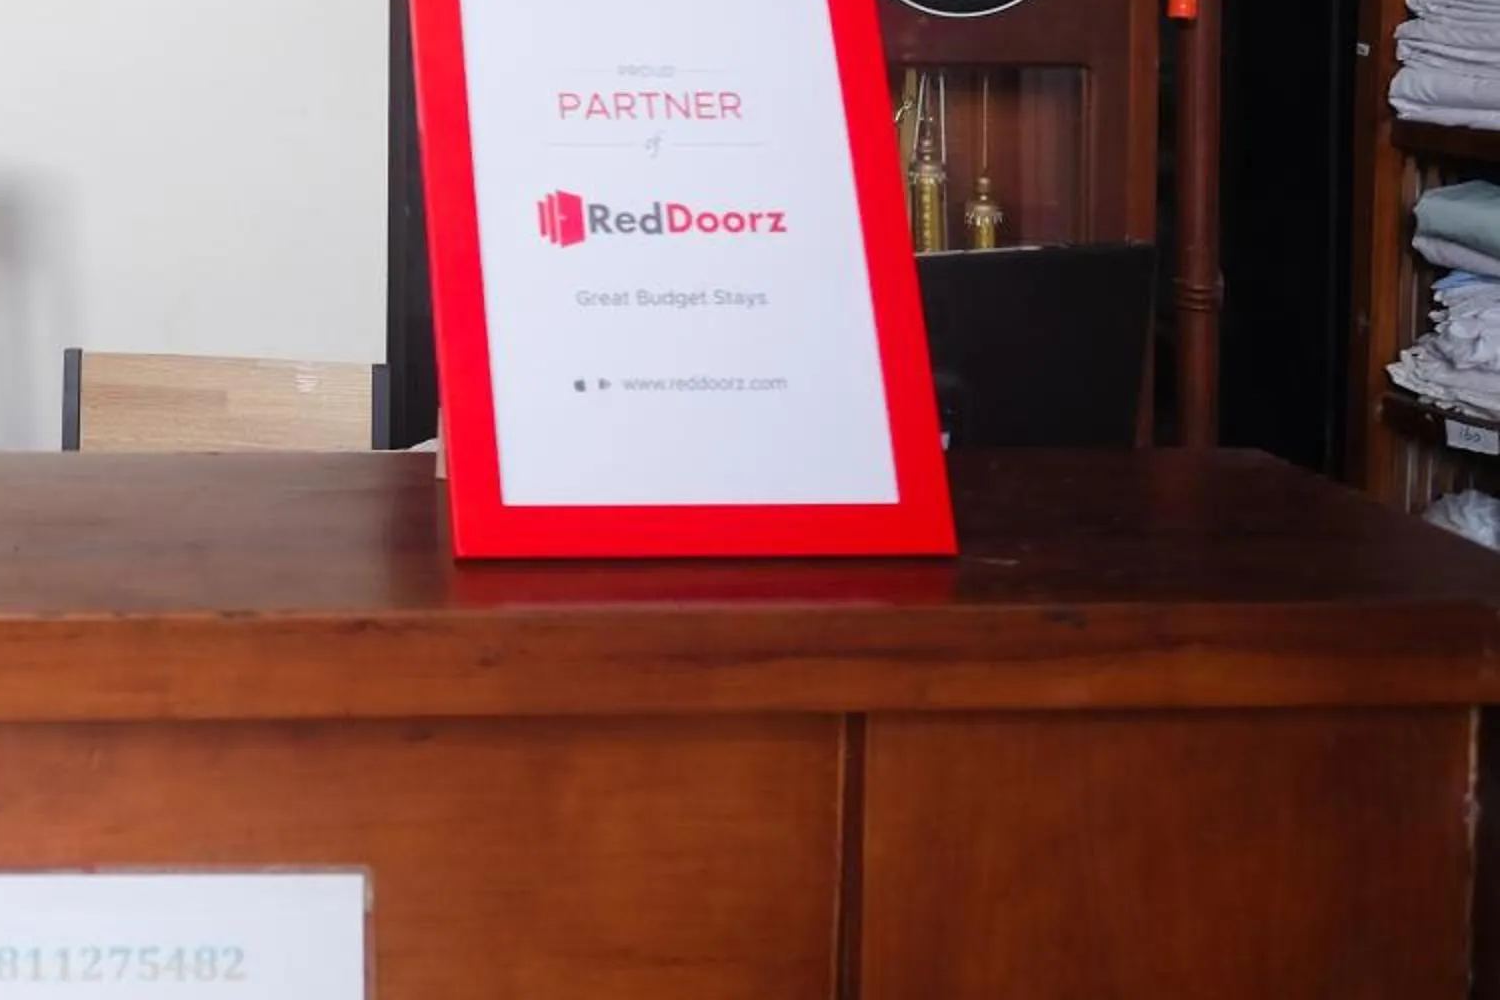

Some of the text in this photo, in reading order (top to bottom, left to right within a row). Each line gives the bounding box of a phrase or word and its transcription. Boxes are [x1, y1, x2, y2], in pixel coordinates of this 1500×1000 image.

[557, 91, 743, 121] PARTNER
[587, 201, 788, 234] RedDoorz
[575, 288, 769, 309] Great Budget Stays
[621, 376, 789, 392] www.reddoorz.com
